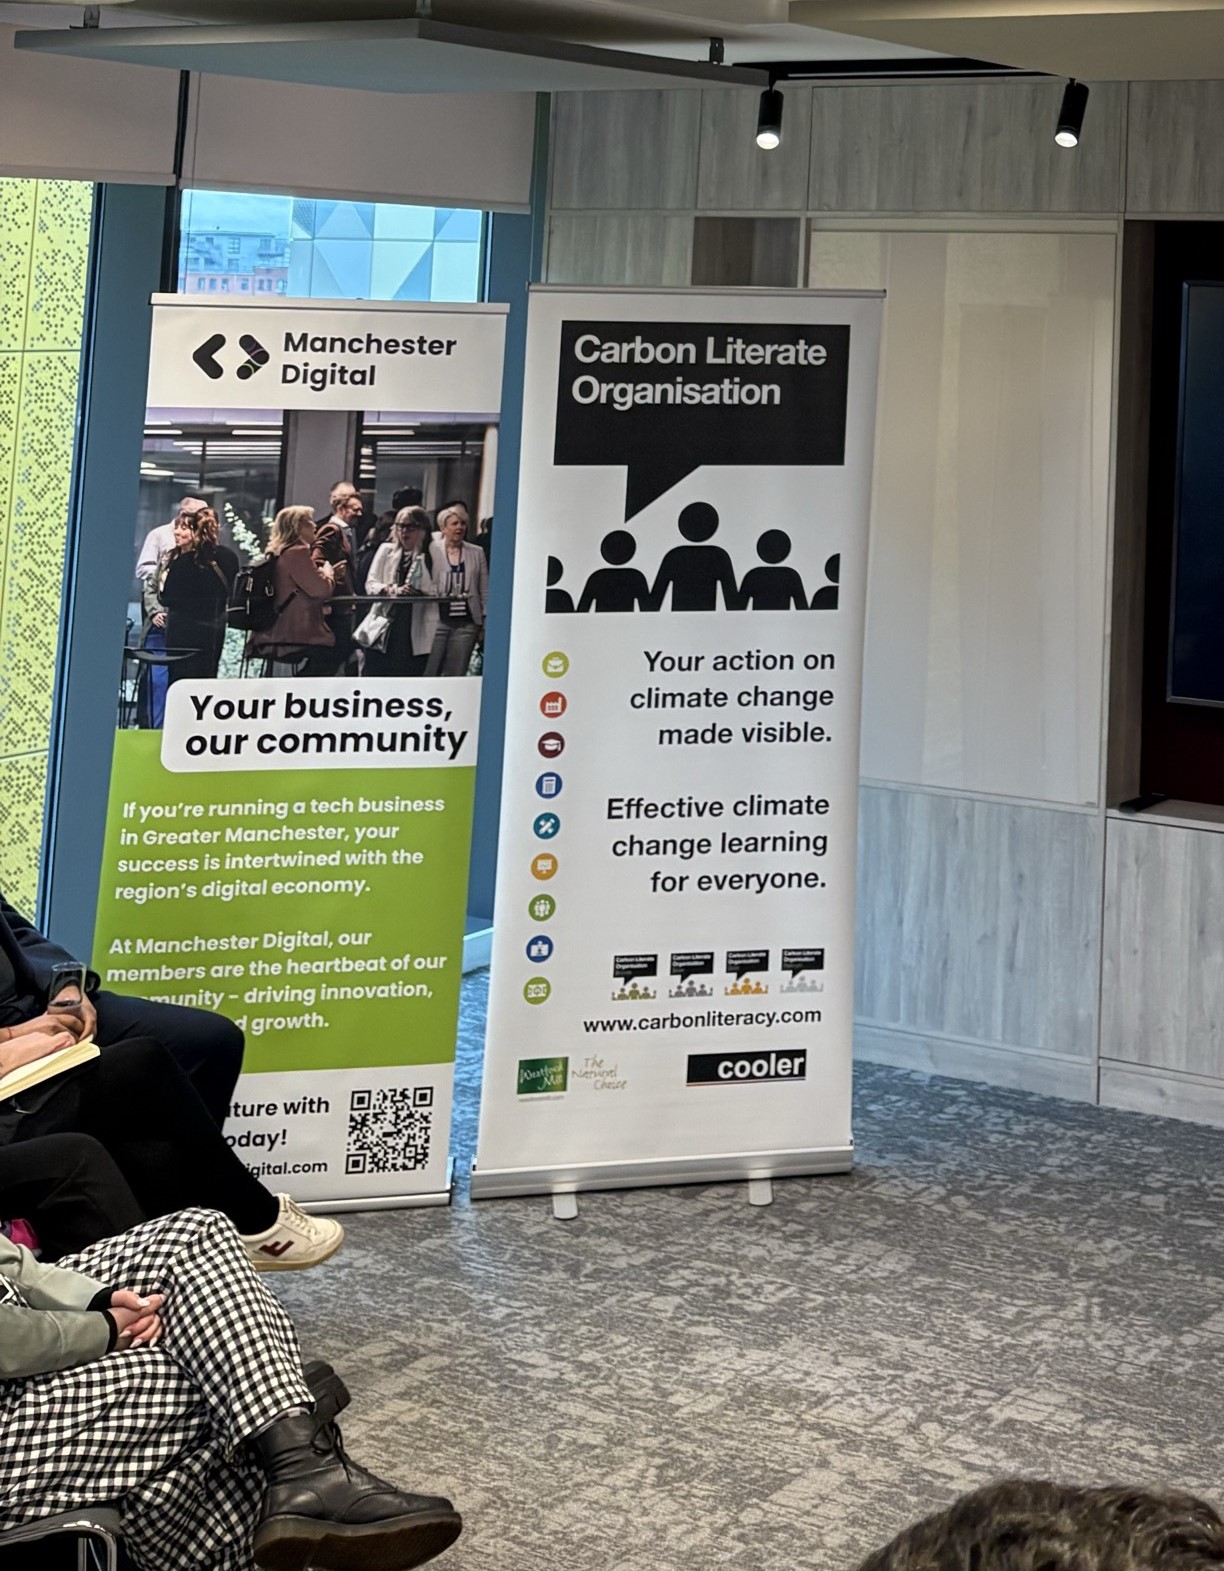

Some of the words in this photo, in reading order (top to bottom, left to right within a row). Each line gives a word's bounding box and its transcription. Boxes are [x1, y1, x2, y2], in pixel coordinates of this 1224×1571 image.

[283, 332, 458, 356] Manchester
[574, 334, 697, 364] Carbon
[706, 336, 827, 366] Literate
[281, 361, 376, 392] Digital
[571, 374, 781, 411] Organisation
[643, 650, 705, 673] Your
[712, 649, 794, 672] action
[803, 653, 835, 671] on
[189, 694, 276, 721] Your
[284, 689, 453, 722] business,
[630, 686, 729, 709] climate
[737, 685, 834, 712] change
[185, 734, 249, 756] our
[256, 723, 469, 761] community
[658, 722, 733, 745] made
[741, 721, 832, 743] visible.
[122, 801, 137, 818] If
[139, 802, 205, 824] you’re
[208, 798, 289, 820] running
[292, 801, 306, 814] a
[310, 797, 354, 814] tech
[357, 795, 445, 813] business
[607, 796, 724, 820] Effective
[732, 794, 830, 817] climate
[120, 828, 139, 846] in
[142, 828, 222, 845] Greater
[224, 824, 350, 843] Manchester,
[354, 826, 400, 844] your
[612, 834, 712, 861] change
[720, 830, 828, 857] learning
[117, 858, 200, 873] success
[203, 853, 221, 871] is
[224, 849, 341, 870] intertwined
[344, 848, 388, 866] with
[391, 848, 424, 865] the
[114, 882, 198, 905] region’s
[201, 878, 268, 902] digital
[271, 879, 371, 897] economy.
[650, 870, 690, 893] for
[697, 872, 826, 895] everyone.
[108, 938, 133, 955] At
[135, 934, 260, 954] Manchester
[262, 930, 334, 953] Digital,
[337, 932, 373, 946] our
[106, 964, 207, 982] members
[210, 964, 245, 978] are
[248, 960, 283, 977] the
[286, 956, 388, 975] heartbeat
[390, 953, 411, 971] of
[413, 956, 448, 970] our
[128, 988, 225, 1011] munity
[243, 984, 317, 1007] driving
[320, 980, 433, 1001] innovation,
[251, 1011, 330, 1036] growth.
[583, 1010, 822, 1033] www.carbonliteracy.com
[717, 1052, 805, 1080] cooler
[225, 1102, 278, 1118] ture
[283, 1096, 330, 1115] with
[225, 1128, 287, 1152] oday!
